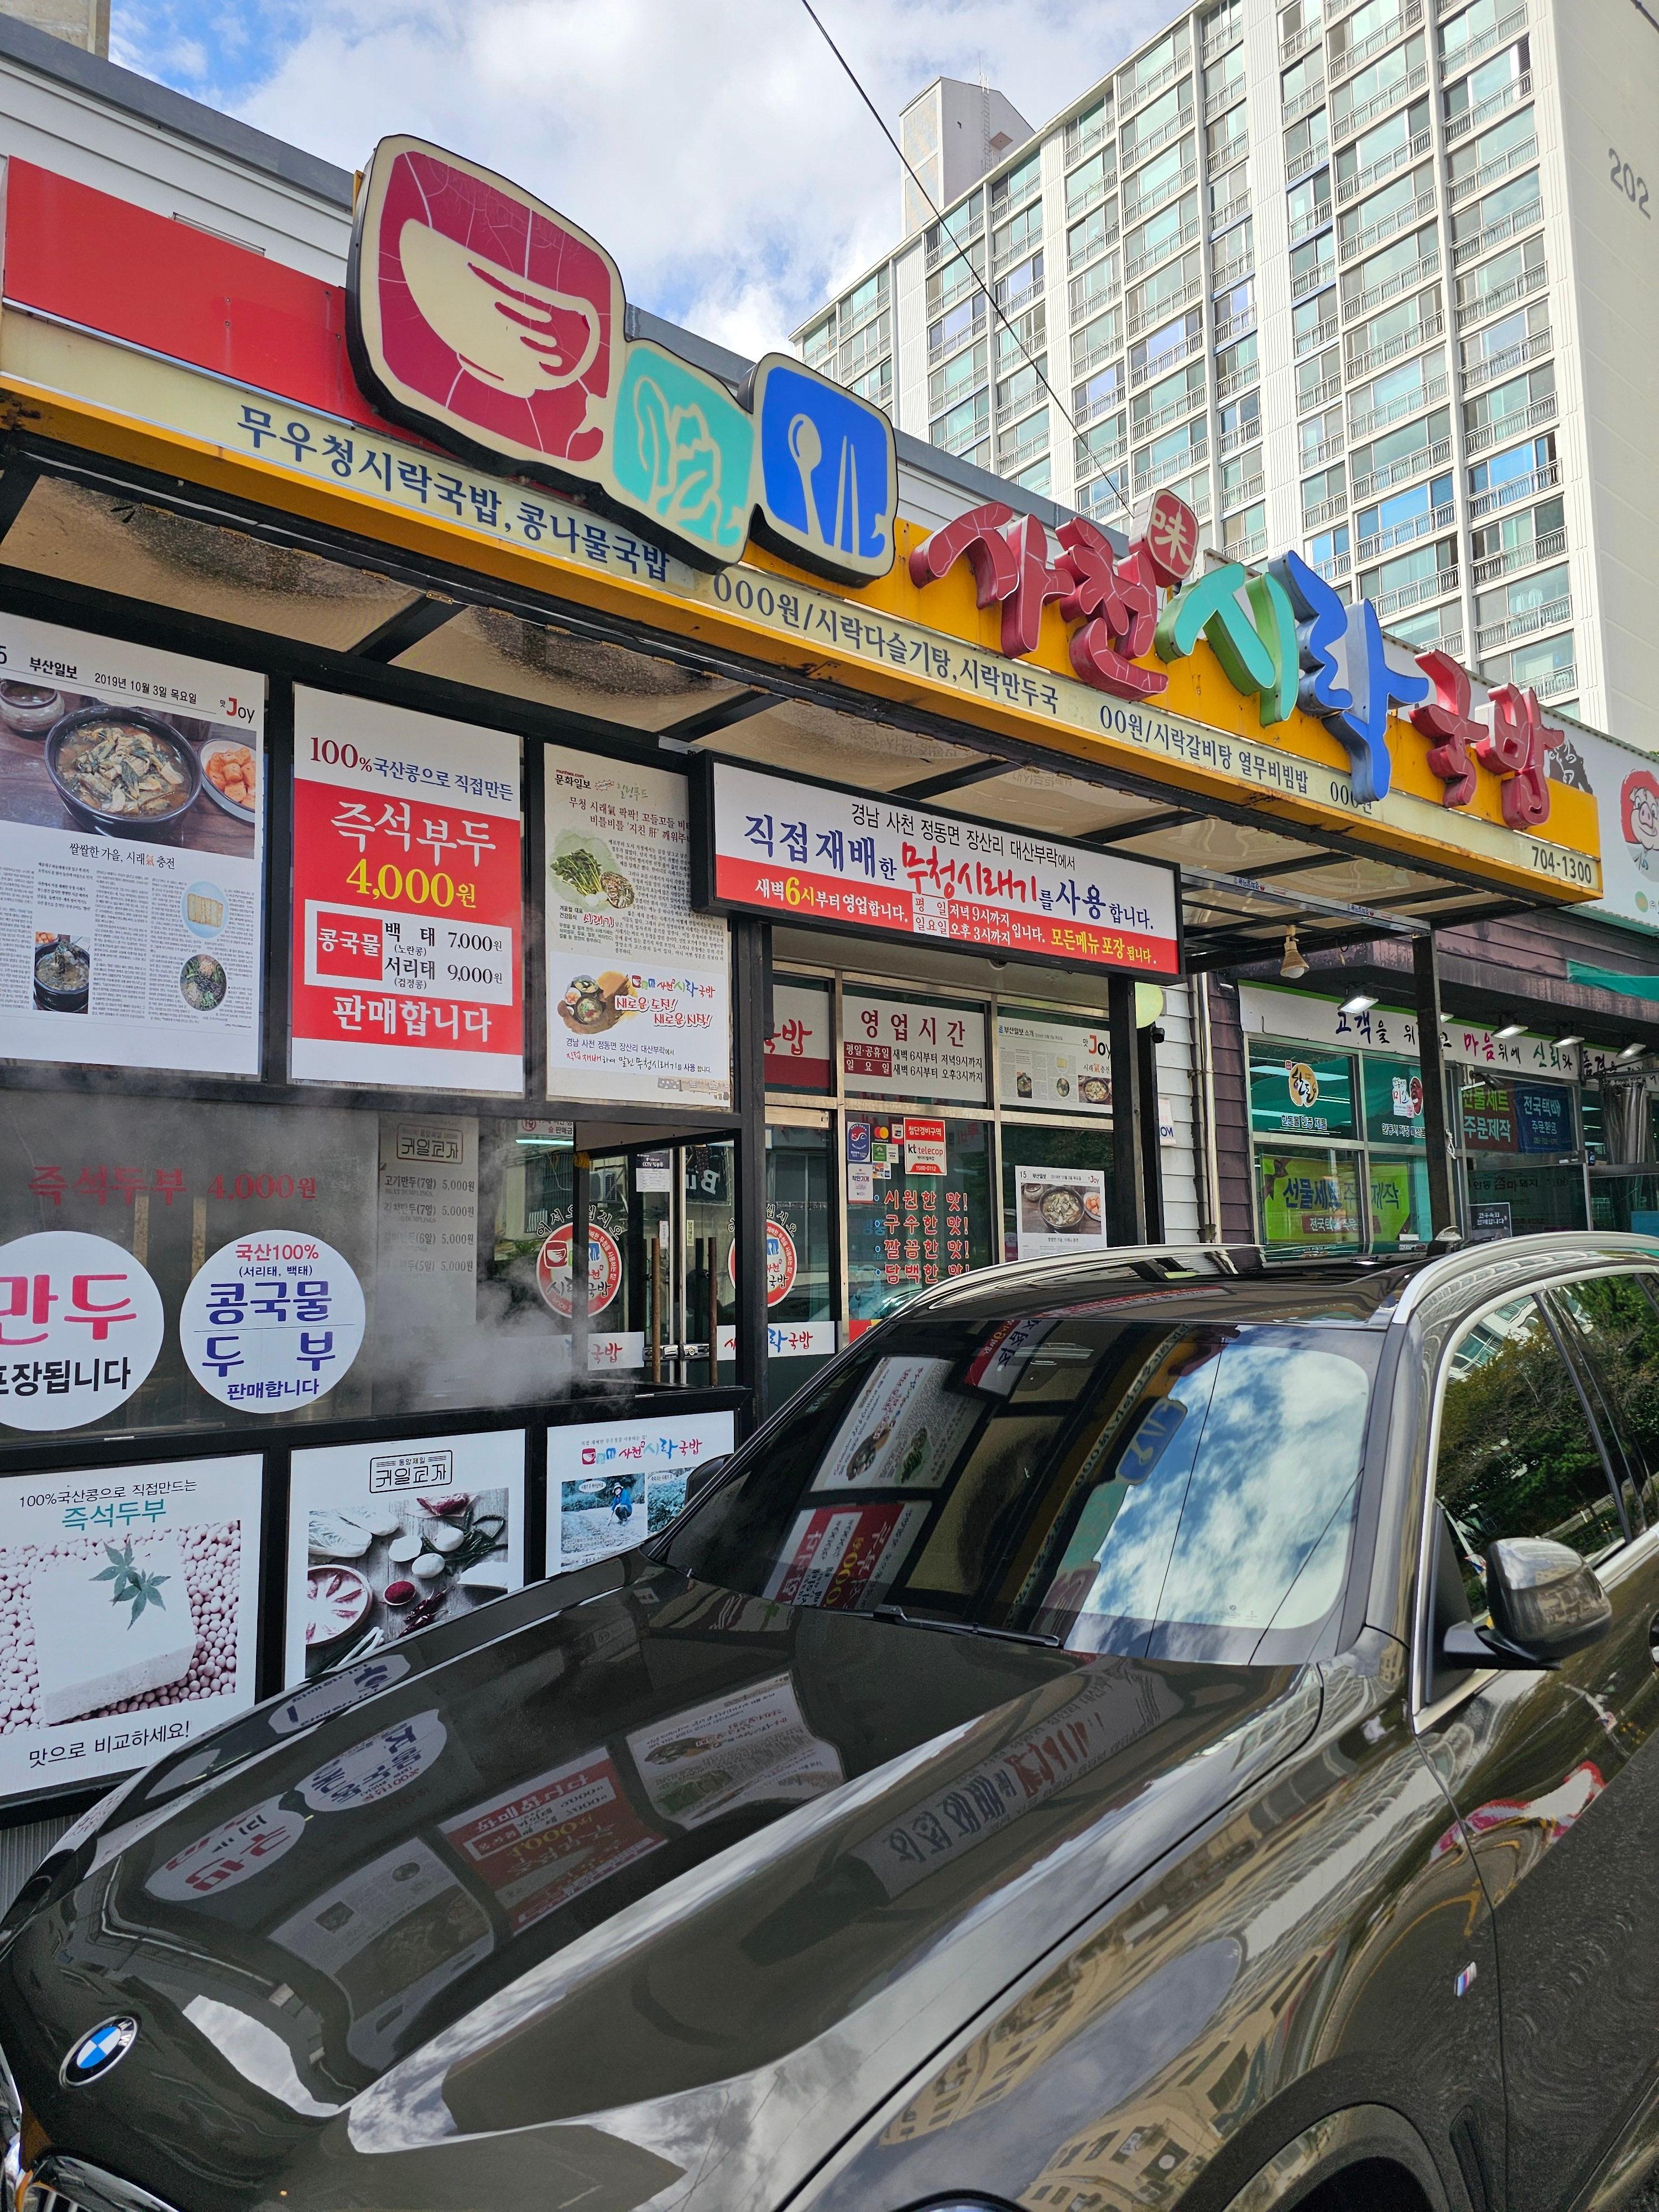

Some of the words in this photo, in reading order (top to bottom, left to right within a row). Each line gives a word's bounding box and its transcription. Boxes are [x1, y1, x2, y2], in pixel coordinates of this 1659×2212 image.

[1608, 148, 1651, 221] 202
[29, 656, 77, 680] 부산일보
[95, 672, 126, 690] 2019년
[131, 680, 150, 694] 10월
[153, 686, 167, 698] 3일
[170, 689, 197, 705] 목요일
[226, 697, 255, 723] Joy
[555, 774, 591, 789] 문화일보
[1238, 752, 1309, 795] 열무비빔밥
[454, 775, 513, 802] 직접만든
[569, 797, 586, 810] 무청
[619, 807, 639, 821] 팍팍!
[643, 813, 675, 828] 꼬들꼬들
[590, 815, 624, 831] 비틀비틀
[852, 802, 880, 829] 경남
[886, 811, 914, 837] 사천
[921, 818, 961, 847] 정동면
[966, 830, 1004, 857] 장산리
[1010, 841, 1076, 871] 대산부락에서
[69, 842, 100, 858] 쌀쌀한
[156, 857, 175, 870] 충전
[1531, 845, 1592, 885] 704-1300
[346, 858, 476, 909] 4,000원
[583, 912, 614, 927] 시래기
[842, 893, 908, 923] 영업합니다.
[950, 902, 970, 921] 저녁
[972, 906, 1009, 927] 9시까지
[317, 927, 382, 957] 콩국물
[447, 930, 503, 953] 7,000원
[915, 916, 947, 935] 일요일
[950, 924, 971, 936] 오후
[973, 927, 1010, 946] 3시까지
[1011, 923, 1045, 943] 입니다.
[1051, 927, 1099, 956] 모든메뉴
[394, 943, 427, 957] (노란콩)
[384, 956, 436, 980] 서리태
[447, 963, 503, 985] 9,000원
[394, 977, 427, 990] (검정콩)
[615, 995, 649, 1011] 새로운
[332, 994, 492, 1043] 판매합니다
[654, 1013, 685, 1026] 새로운
[1335, 1011, 1390, 1045] 고객을
[566, 1037, 579, 1047] 경남
[582, 1039, 595, 1048] 사천
[598, 1041, 617, 1050] 정동면
[619, 1043, 638, 1052] 장산리
[641, 1045, 674, 1056] 대산부락에서
[1083, 1039, 1088, 1047] 맛
[893, 1050, 908, 1062] 새벽
[910, 1051, 937, 1065] 6시부터
[941, 1053, 983, 1069] 저녁9시까지
[893, 1063, 908, 1076] 새벽
[910, 1066, 938, 1079] 6시부터
[941, 1068, 983, 1083] 오후3시까지
[1524, 1095, 1561, 1117] 전국택배
[908, 1125, 942, 1137] 첨단경비구역
[1464, 1115, 1511, 1143] 주문제작
[908, 1144, 917, 1154] kt
[919, 1145, 943, 1156] telecop
[28, 1165, 188, 1207] 즉석두부
[884, 1190, 937, 1210] 시원한
[946, 1191, 968, 1212] 맛!
[884, 1214, 938, 1235] 구수한
[946, 1215, 968, 1235] 맛!
[235, 1244, 319, 1262] 국산100%
[884, 1239, 938, 1260] 깔끔한
[947, 1240, 969, 1260] 맛!
[885, 1263, 938, 1284] 담백한
[0, 1274, 137, 1345] 만두
[206, 1280, 332, 1326] 콩국물
[227, 1379, 319, 1401] 판매합니다
[398, 1456, 426, 1467] 동양제일
[132, 1479, 197, 1498] 직접만드는
[61, 1498, 167, 1531] 즉석두부
[29, 1743, 87, 1769] 맛으로
[95, 1720, 190, 1754] 비교하세요!
